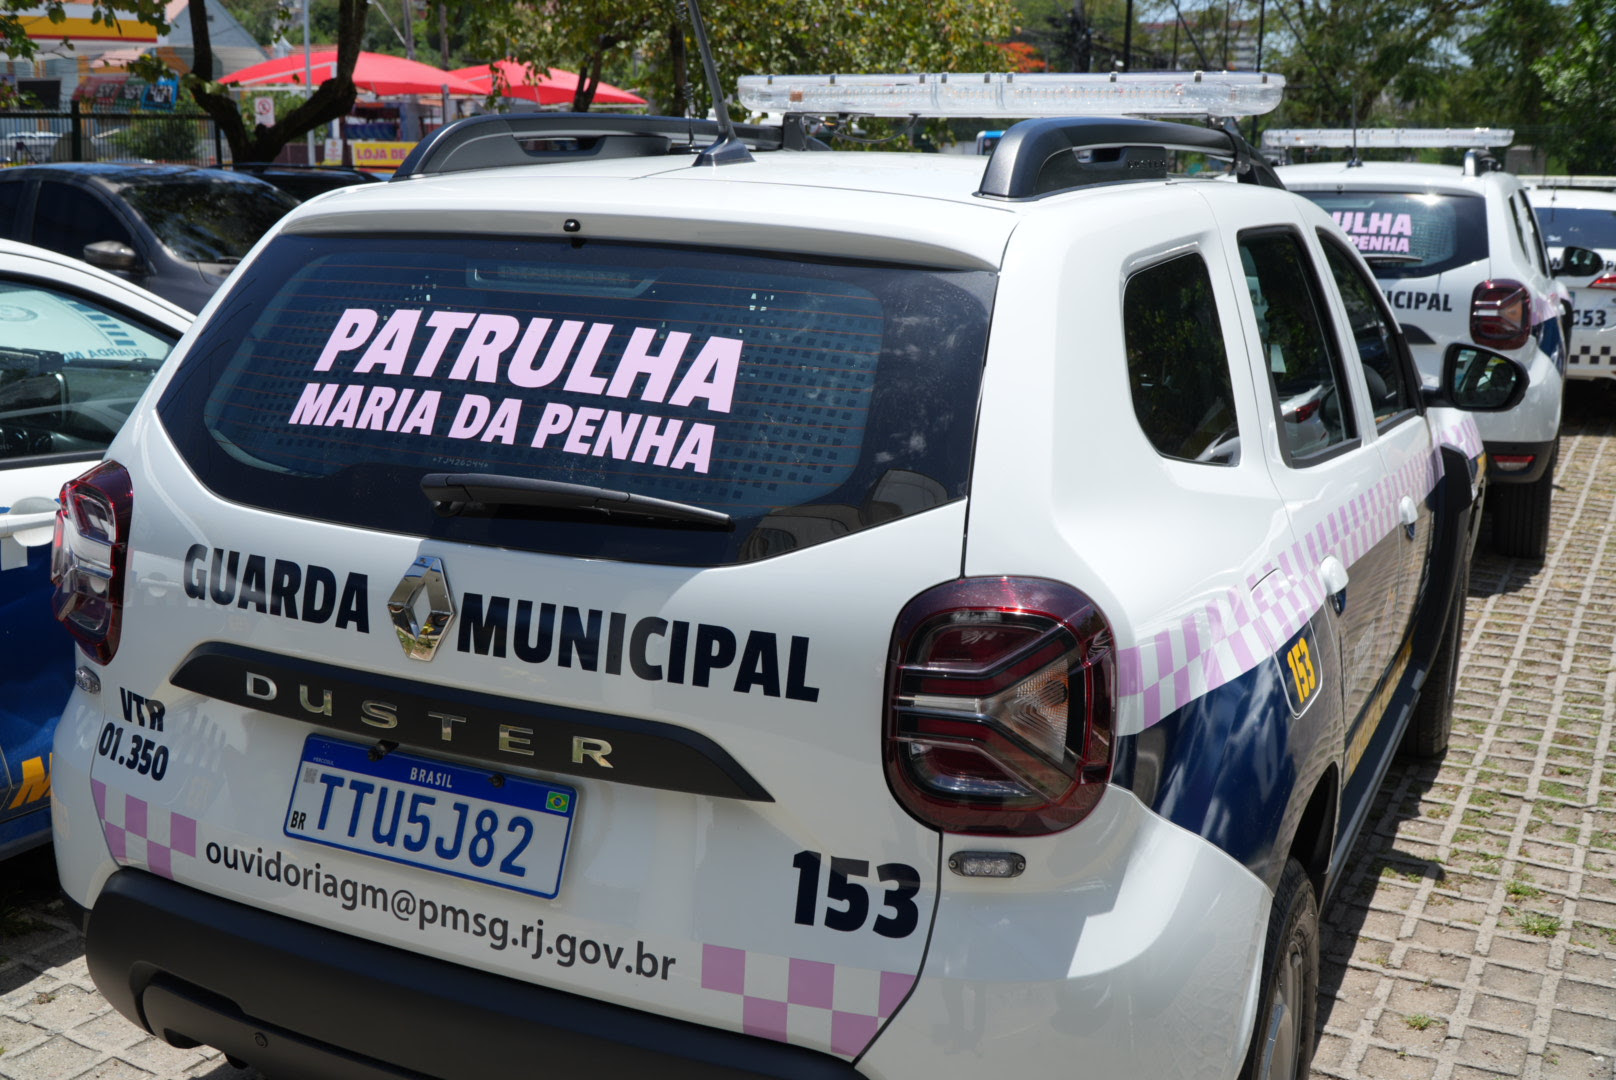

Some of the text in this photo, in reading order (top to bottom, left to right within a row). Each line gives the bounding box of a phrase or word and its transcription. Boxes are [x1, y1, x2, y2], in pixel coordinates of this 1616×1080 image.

[356, 148, 388, 160] LOJA
[1332, 211, 1412, 236] ULHA
[1384, 290, 1453, 312] ICIPAL
[312, 308, 744, 414] PATRULHA
[288, 382, 716, 474] MARIA DA PENHA
[184, 543, 820, 703] GUARDA MUNICIPAL
[1287, 637, 1316, 704] 153
[120, 687, 165, 732] VTR
[245, 671, 615, 769] DUSTER
[98, 722, 169, 781] 01.350
[410, 767, 453, 788] BRASIL
[290, 811, 307, 831] BR
[316, 772, 534, 878] TTU5J82
[205, 841, 677, 982] ouvidoriagm@pmsg.rj.gov.br
[792, 849, 921, 939] 153
